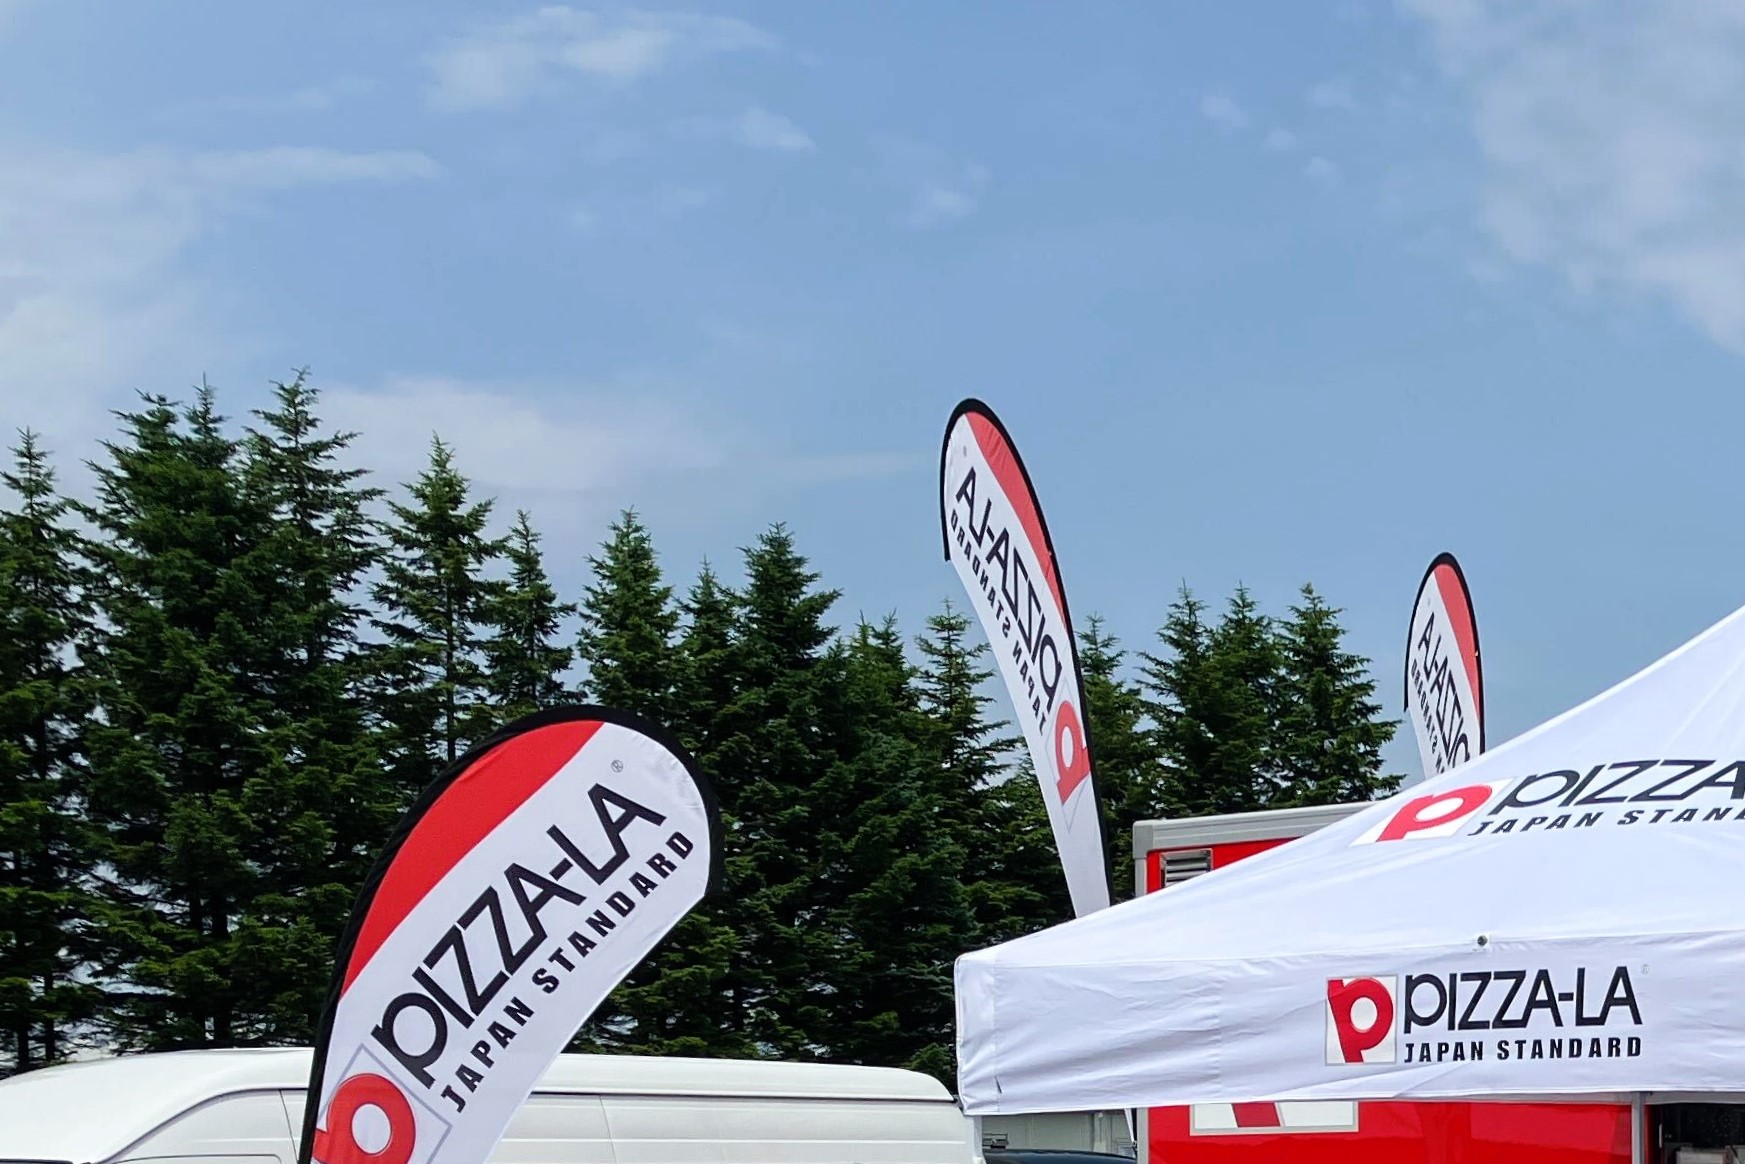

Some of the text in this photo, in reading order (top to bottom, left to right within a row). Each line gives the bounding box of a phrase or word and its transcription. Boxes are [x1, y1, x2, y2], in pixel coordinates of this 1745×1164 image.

[1468, 810, 1602, 837] JAPAN
[370, 783, 667, 1089] PIZZA-LA
[438, 830, 694, 1113] JAPAN STANDARD
[1403, 966, 1644, 1035] PIZZA-LA
[1404, 1036, 1643, 1064] JAPAN STANDARD
